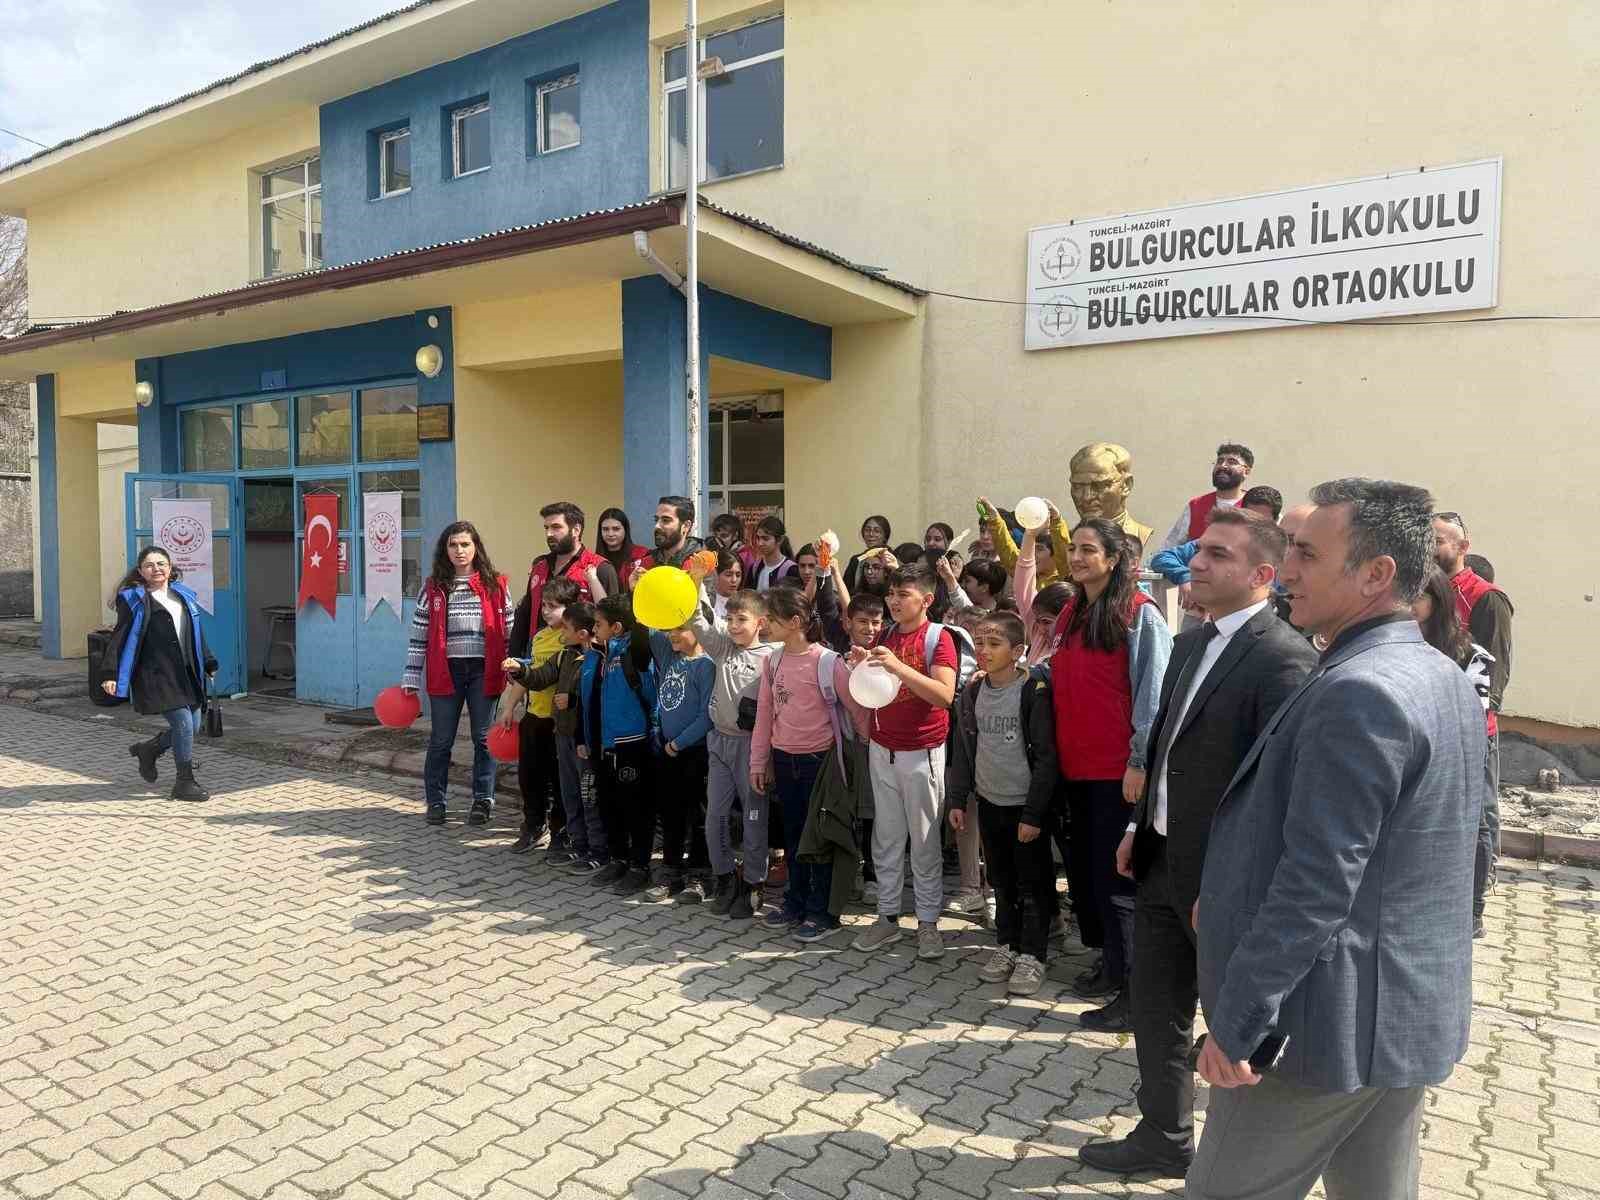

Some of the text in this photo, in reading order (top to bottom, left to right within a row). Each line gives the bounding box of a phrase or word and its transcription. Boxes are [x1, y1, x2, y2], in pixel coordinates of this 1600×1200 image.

[1089, 219, 1171, 238] TUNCELİ-MAZGİRT
[1090, 215, 1295, 272] BULGURCULAR
[1311, 189, 1480, 244] İLKOKULU
[1088, 278, 1170, 295] TUNCELİ-MAZGİRT
[1088, 280, 1279, 330] BULGURCULAR
[1292, 258, 1475, 309] ORTAOKULU
